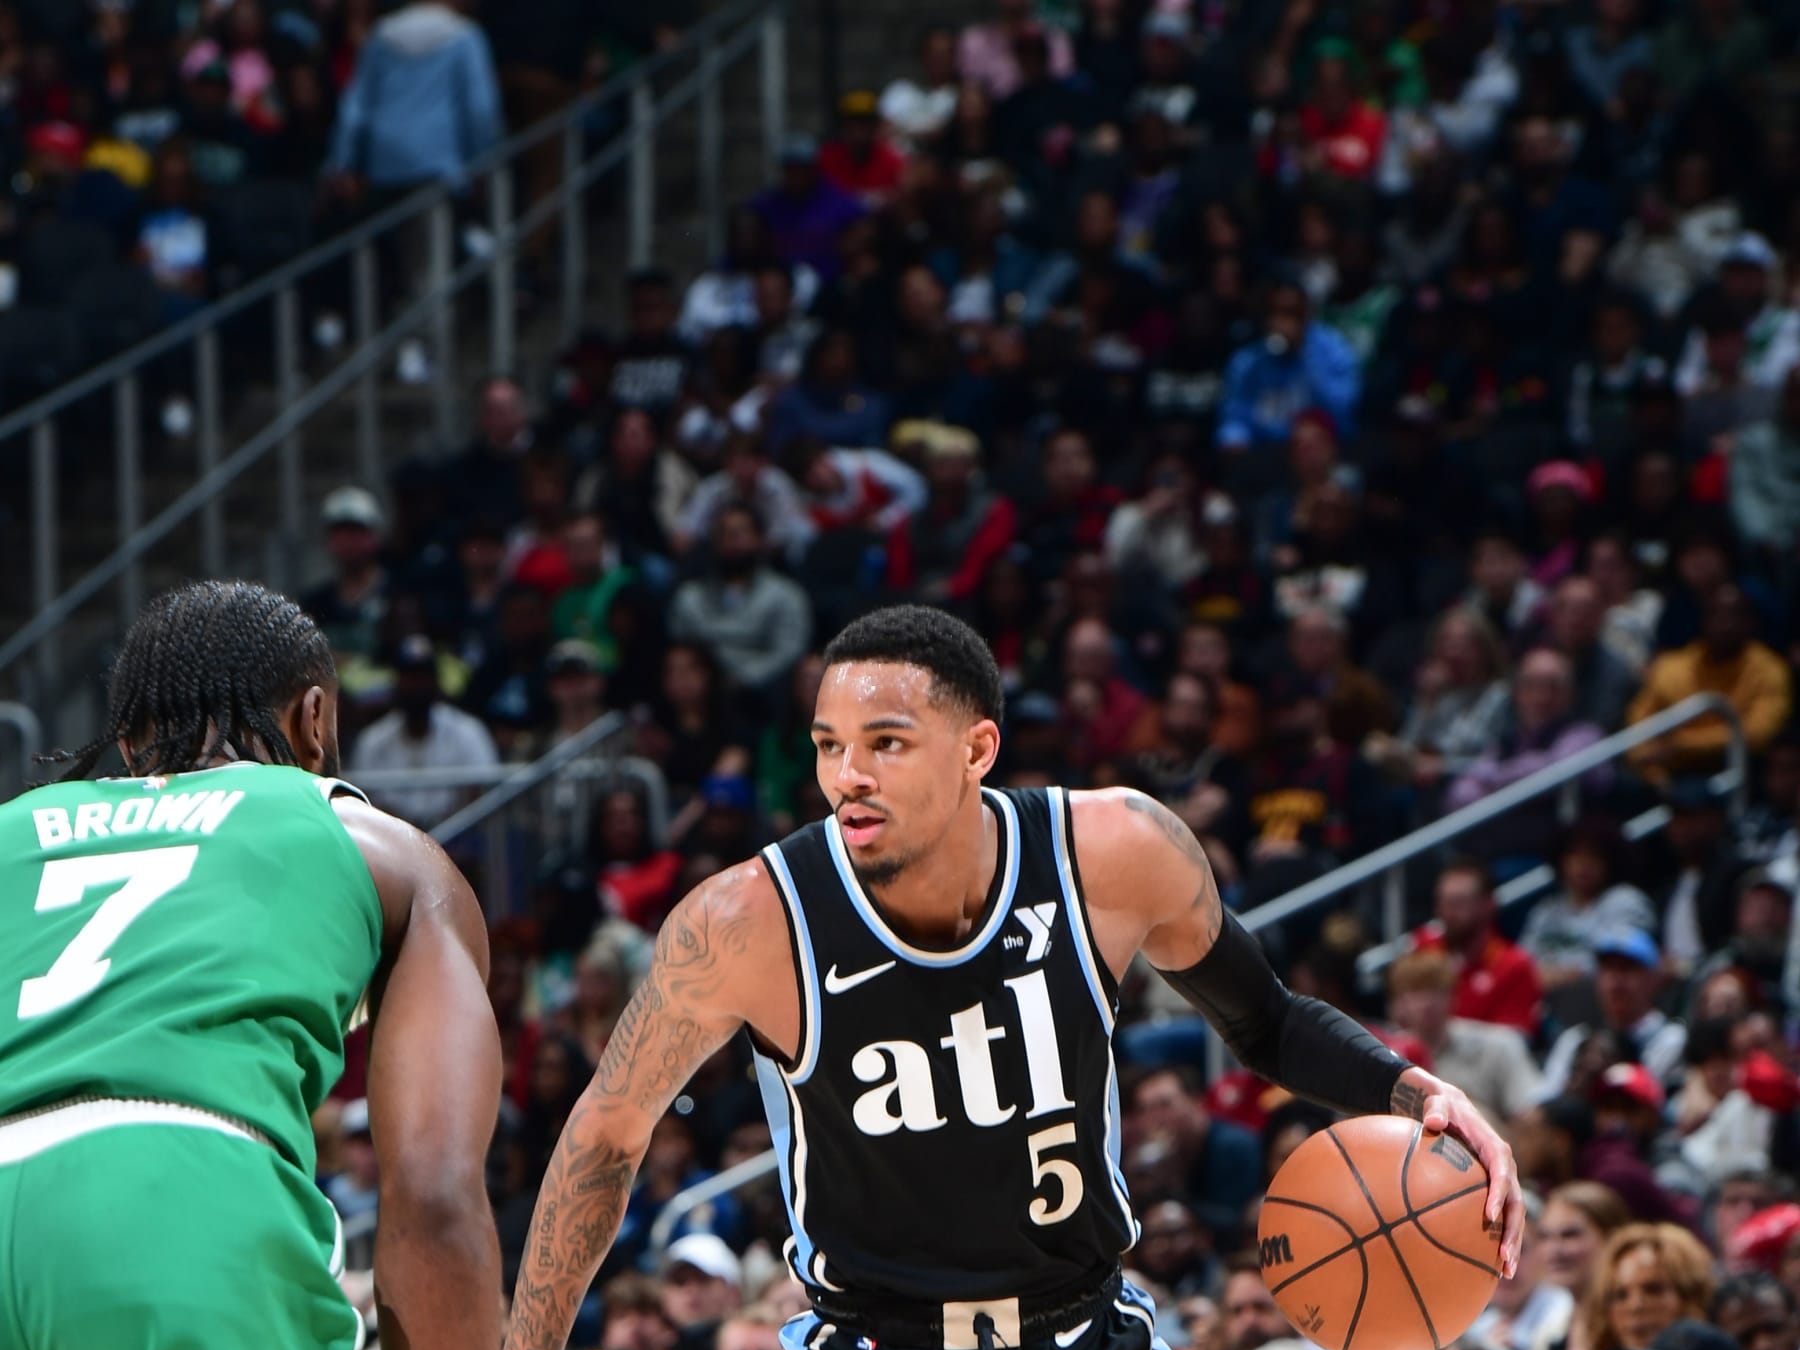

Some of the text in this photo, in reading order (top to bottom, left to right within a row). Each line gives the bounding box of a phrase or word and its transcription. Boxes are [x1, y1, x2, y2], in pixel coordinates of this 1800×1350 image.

[32, 790, 246, 849] BROWN
[17, 844, 200, 1019] 7
[1003, 935, 1024, 950] the
[851, 969, 1076, 1136] atl
[1027, 1122, 1084, 1226] 5
